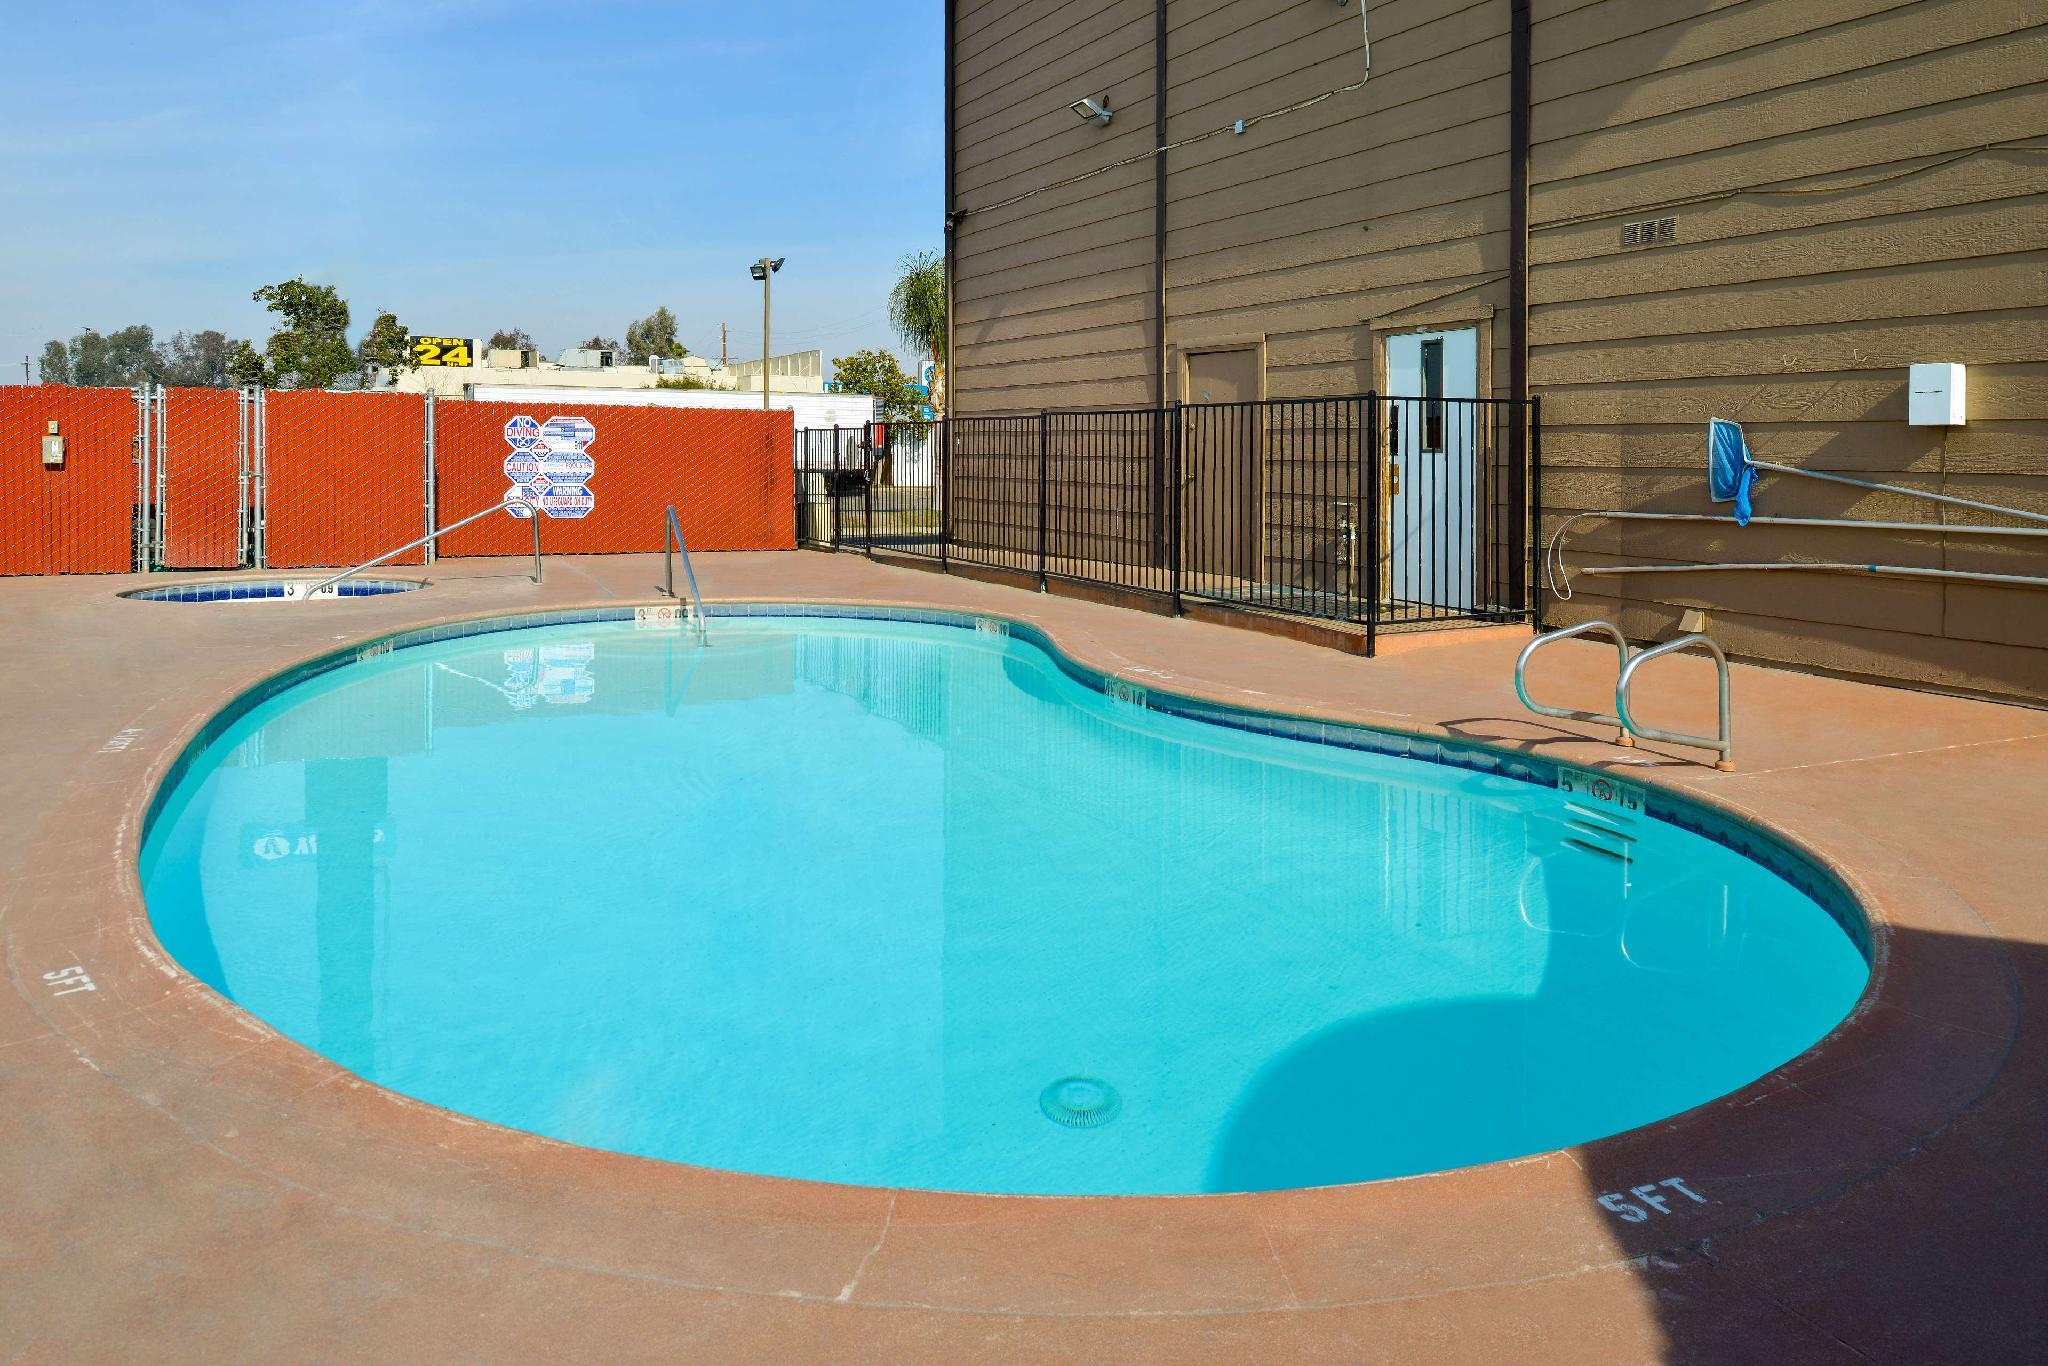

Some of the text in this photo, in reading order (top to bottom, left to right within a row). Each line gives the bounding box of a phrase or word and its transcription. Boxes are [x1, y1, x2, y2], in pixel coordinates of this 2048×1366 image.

[420, 337, 464, 346] OPEN
[413, 344, 472, 367] 24
[518, 417, 531, 428] NO
[506, 427, 540, 437] DIVING
[506, 462, 539, 472] CAUTION
[552, 486, 583, 496] WARNING
[43, 966, 96, 996] 5FT
[1597, 1177, 1707, 1222] 5FT
